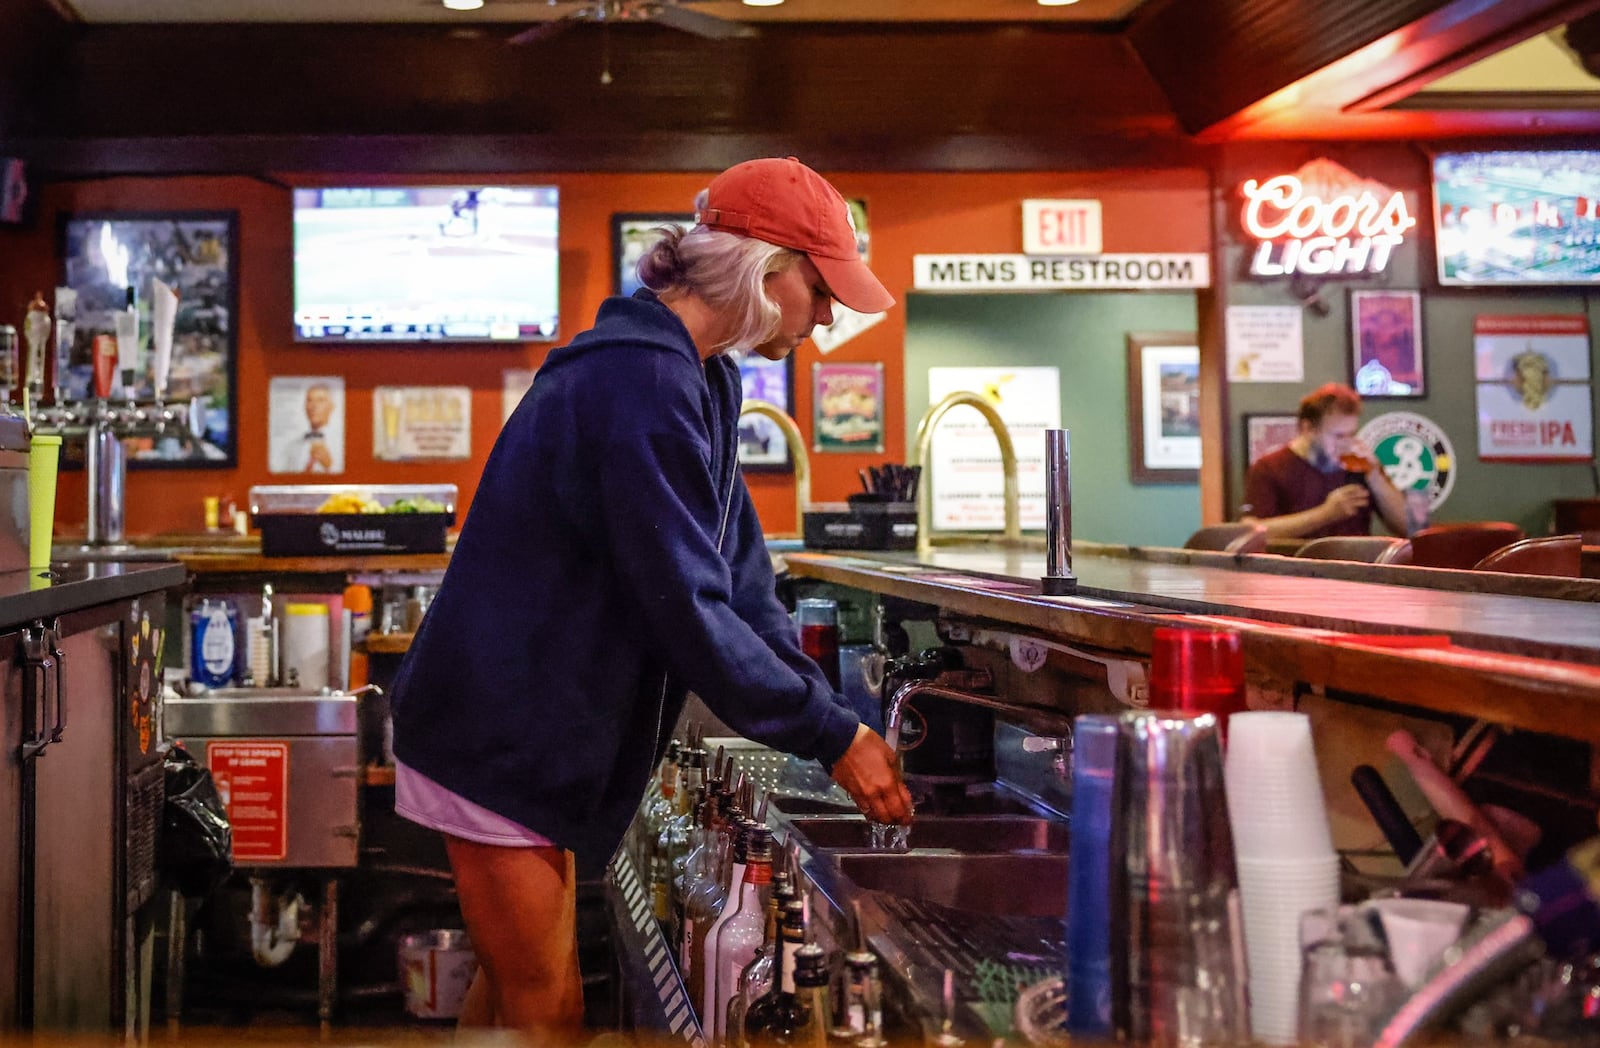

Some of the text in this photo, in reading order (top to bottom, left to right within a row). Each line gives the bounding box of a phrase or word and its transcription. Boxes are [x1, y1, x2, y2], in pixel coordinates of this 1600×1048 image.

[1243, 174, 1416, 238] Coors
[1038, 208, 1088, 246] EXIT
[929, 260, 1194, 282] MENS RESTROOM
[1253, 234, 1404, 276] LIGHT
[1539, 419, 1577, 446] IPA
